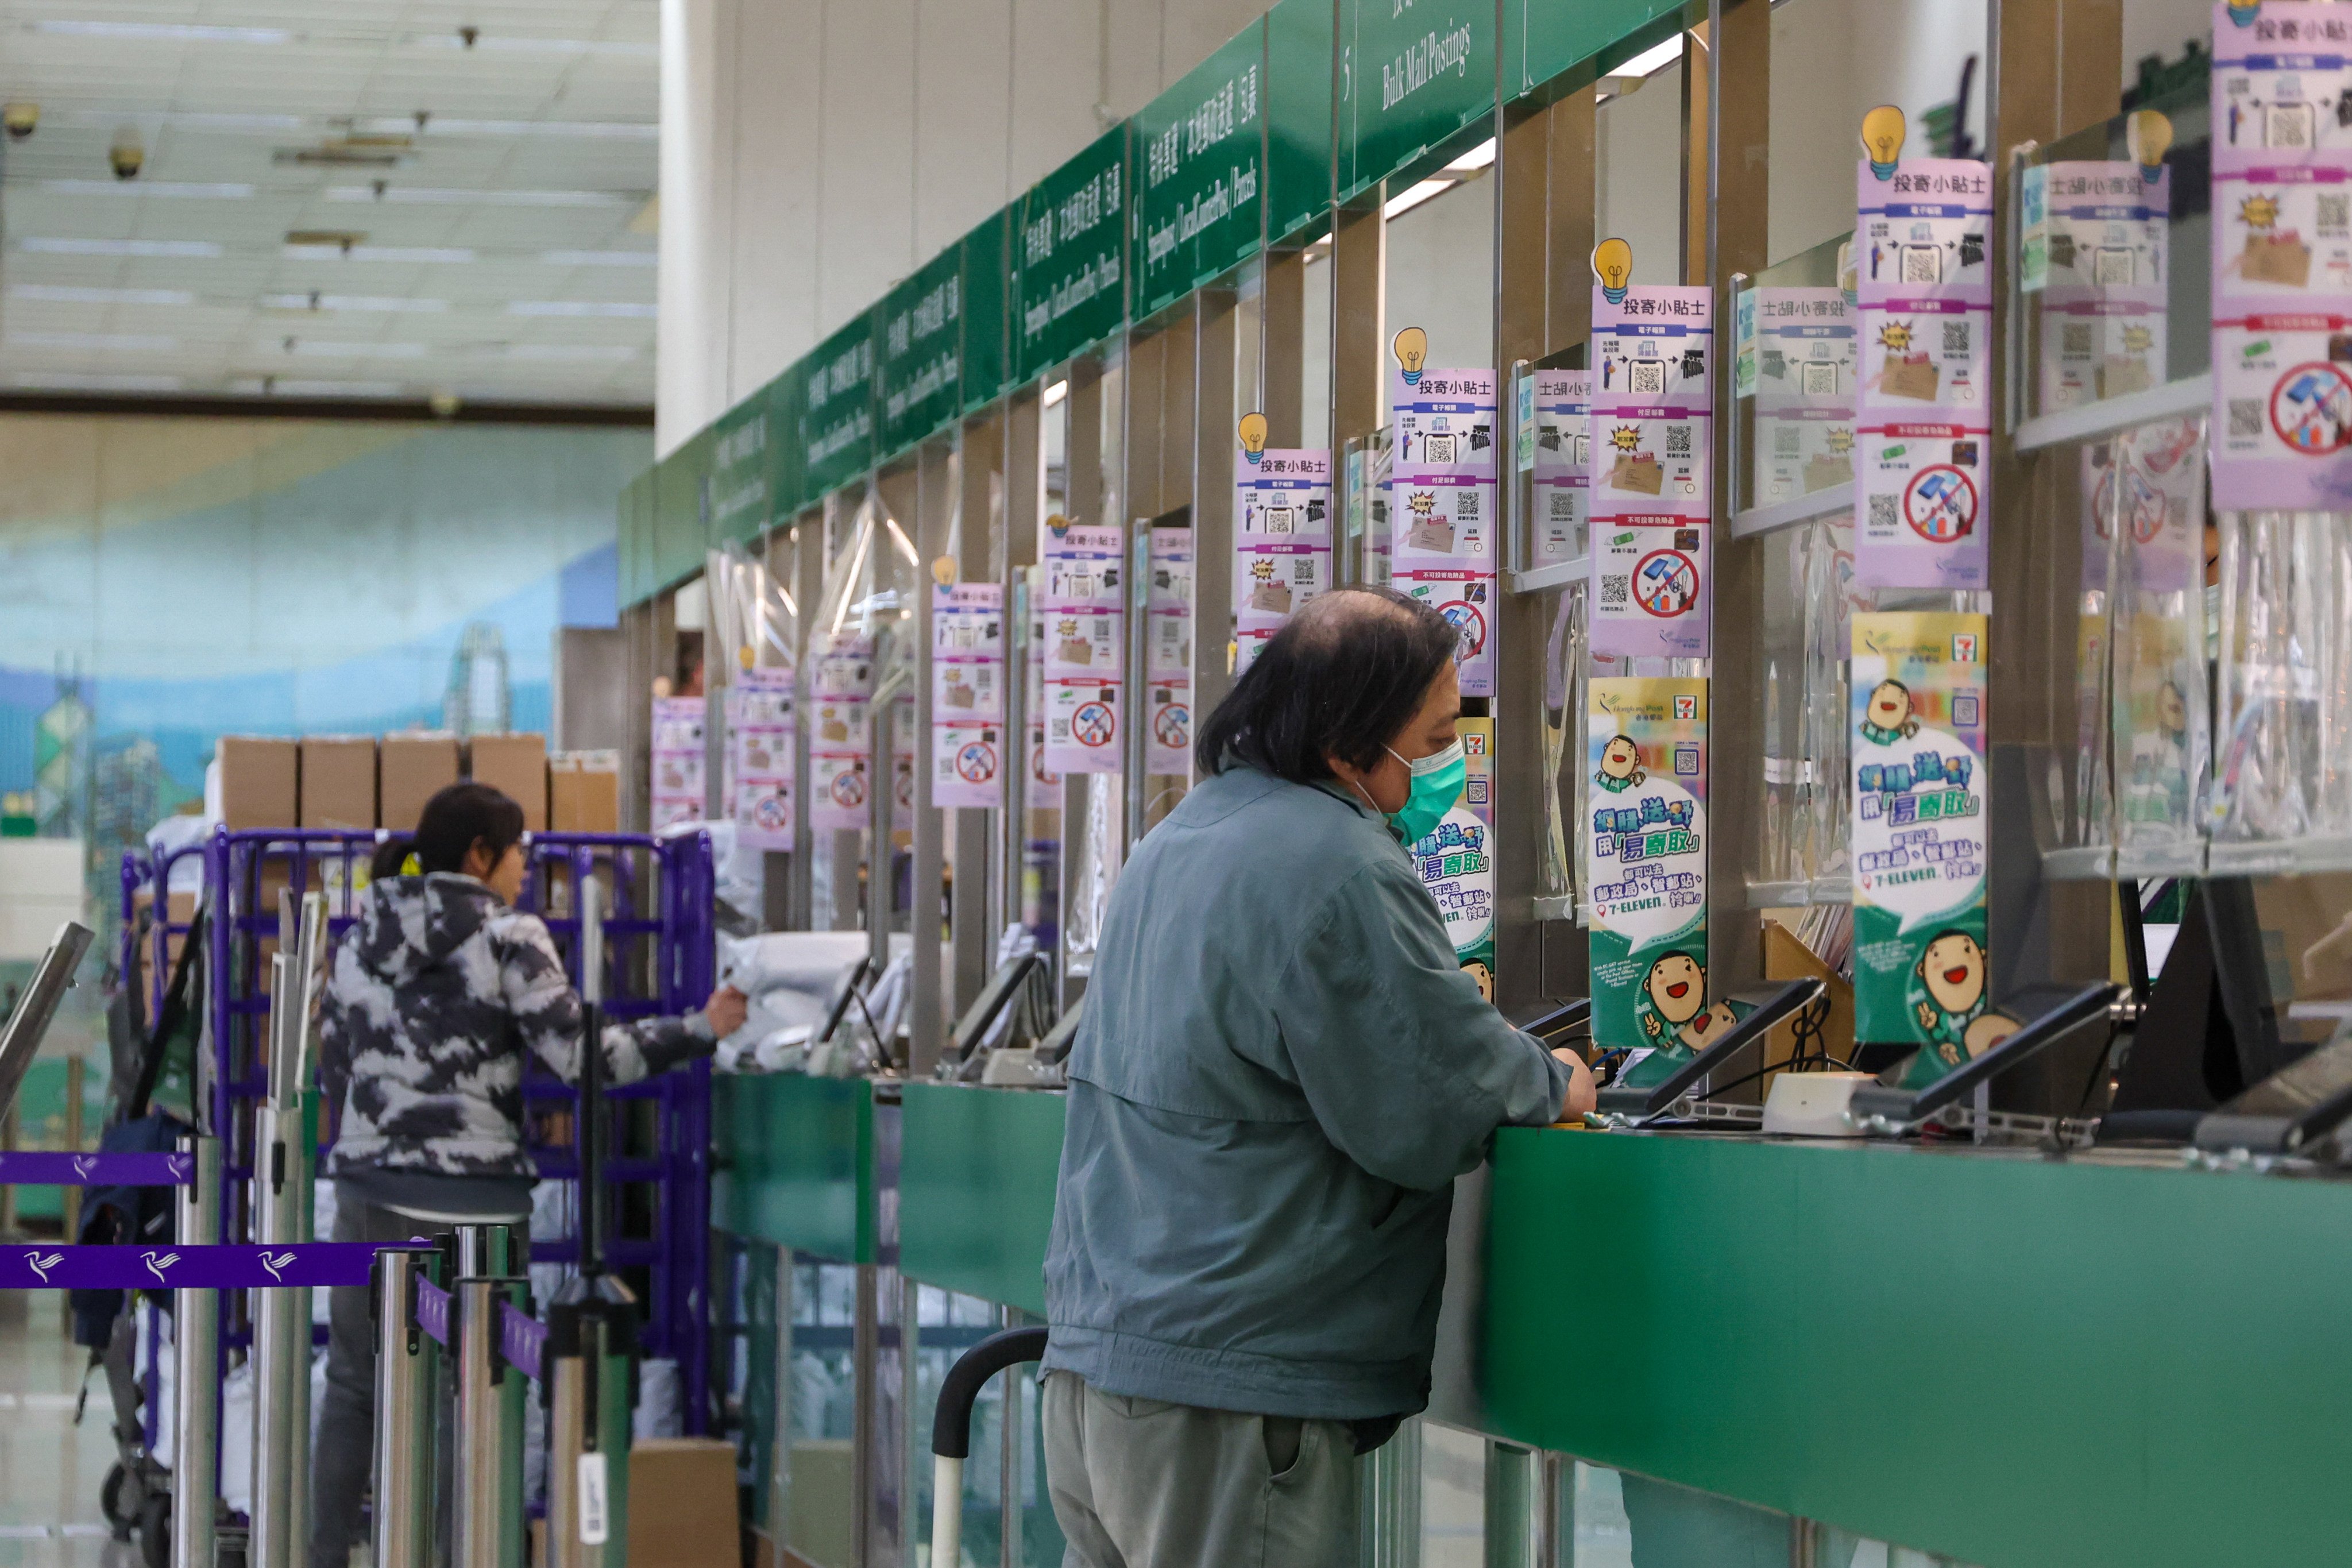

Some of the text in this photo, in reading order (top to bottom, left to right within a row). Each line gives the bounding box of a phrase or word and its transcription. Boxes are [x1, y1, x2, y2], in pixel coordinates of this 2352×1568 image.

[1343, 45, 1350, 101] 5
[1382, 17, 1470, 111] Bulk Mail Postings
[1894, 174, 1986, 193] 投寄小貼士
[1624, 298, 1705, 315] 投寄小貼士
[1419, 380, 1492, 395] 投寄小貼士
[1261, 460, 1326, 473] 投寄小貼士
[1469, 736, 1481, 754] 7
